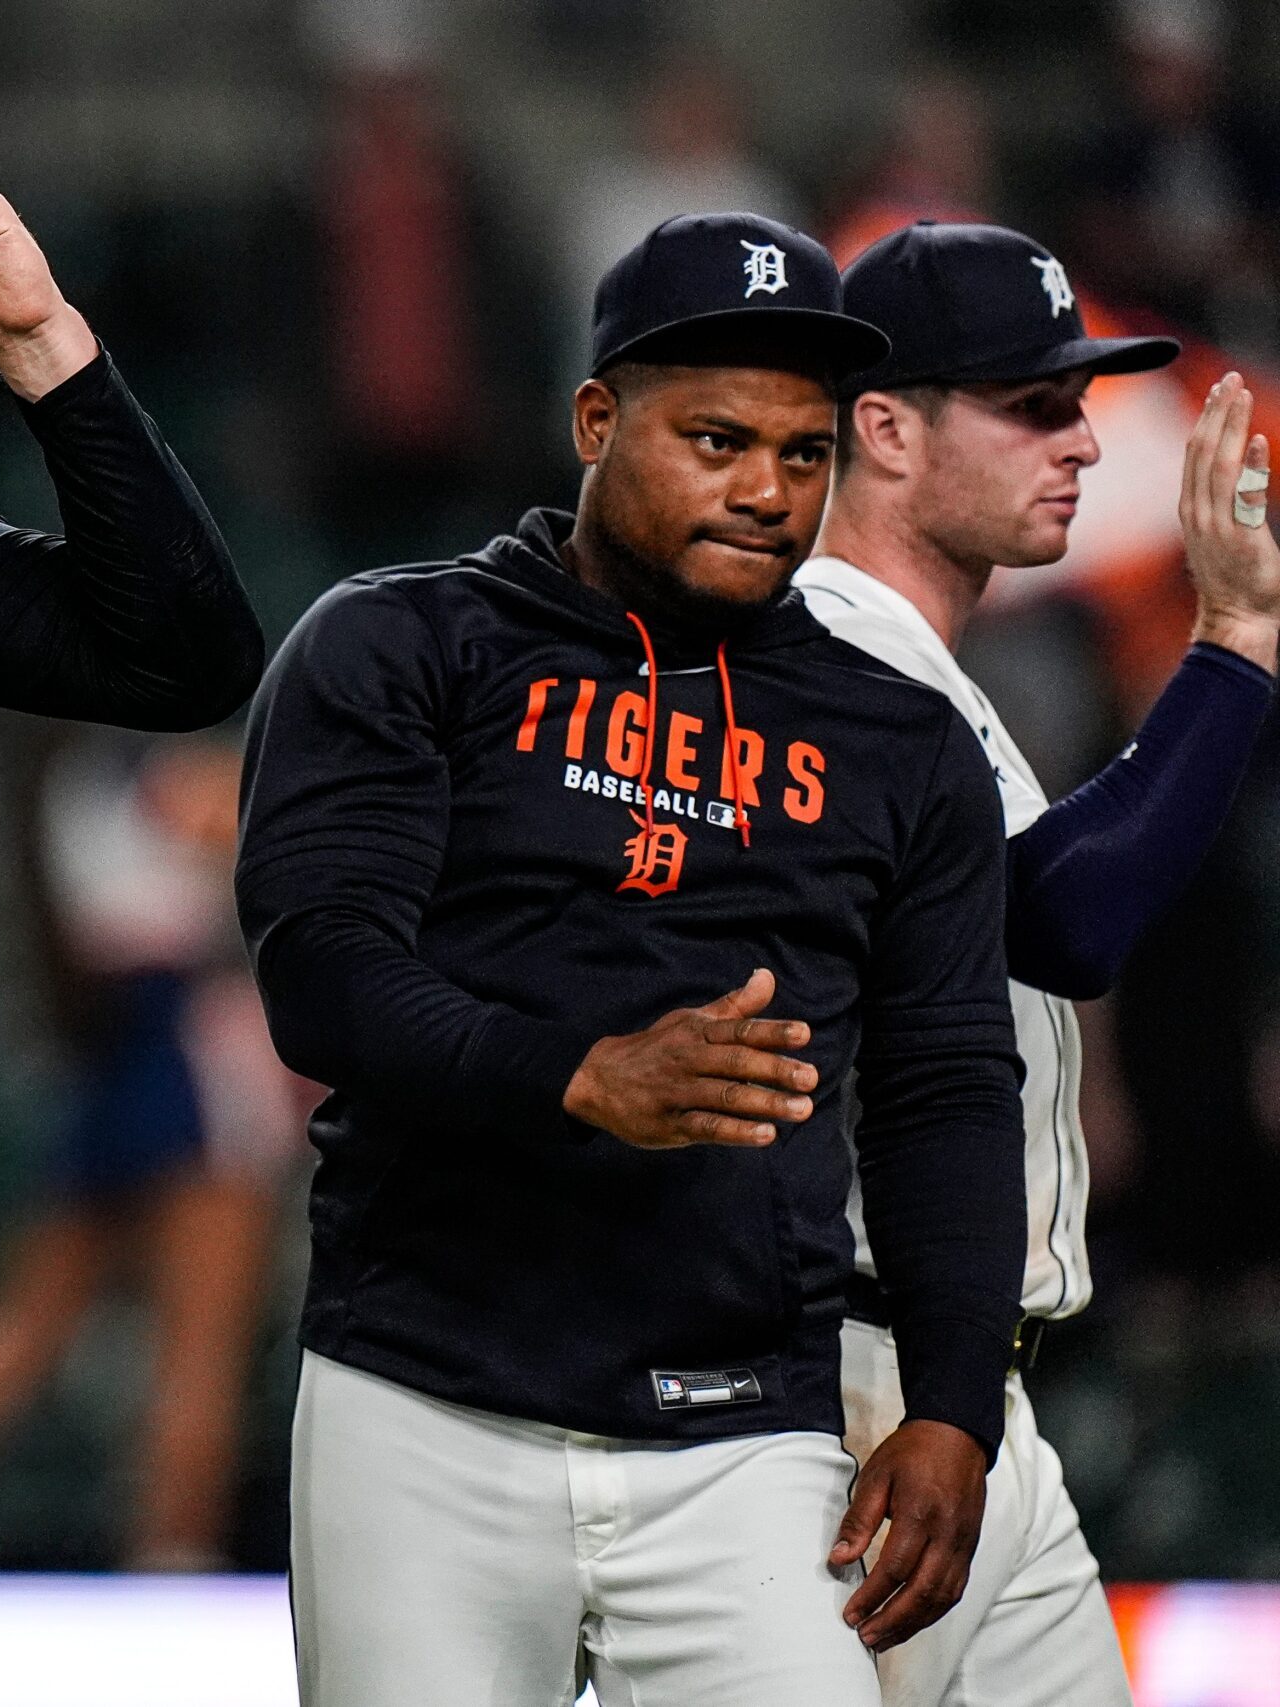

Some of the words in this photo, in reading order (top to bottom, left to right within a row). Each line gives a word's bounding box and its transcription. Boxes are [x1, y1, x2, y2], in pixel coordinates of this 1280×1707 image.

[740, 239, 789, 299] D
[516, 677, 826, 825] TIGERS
[615, 807, 689, 899] D
